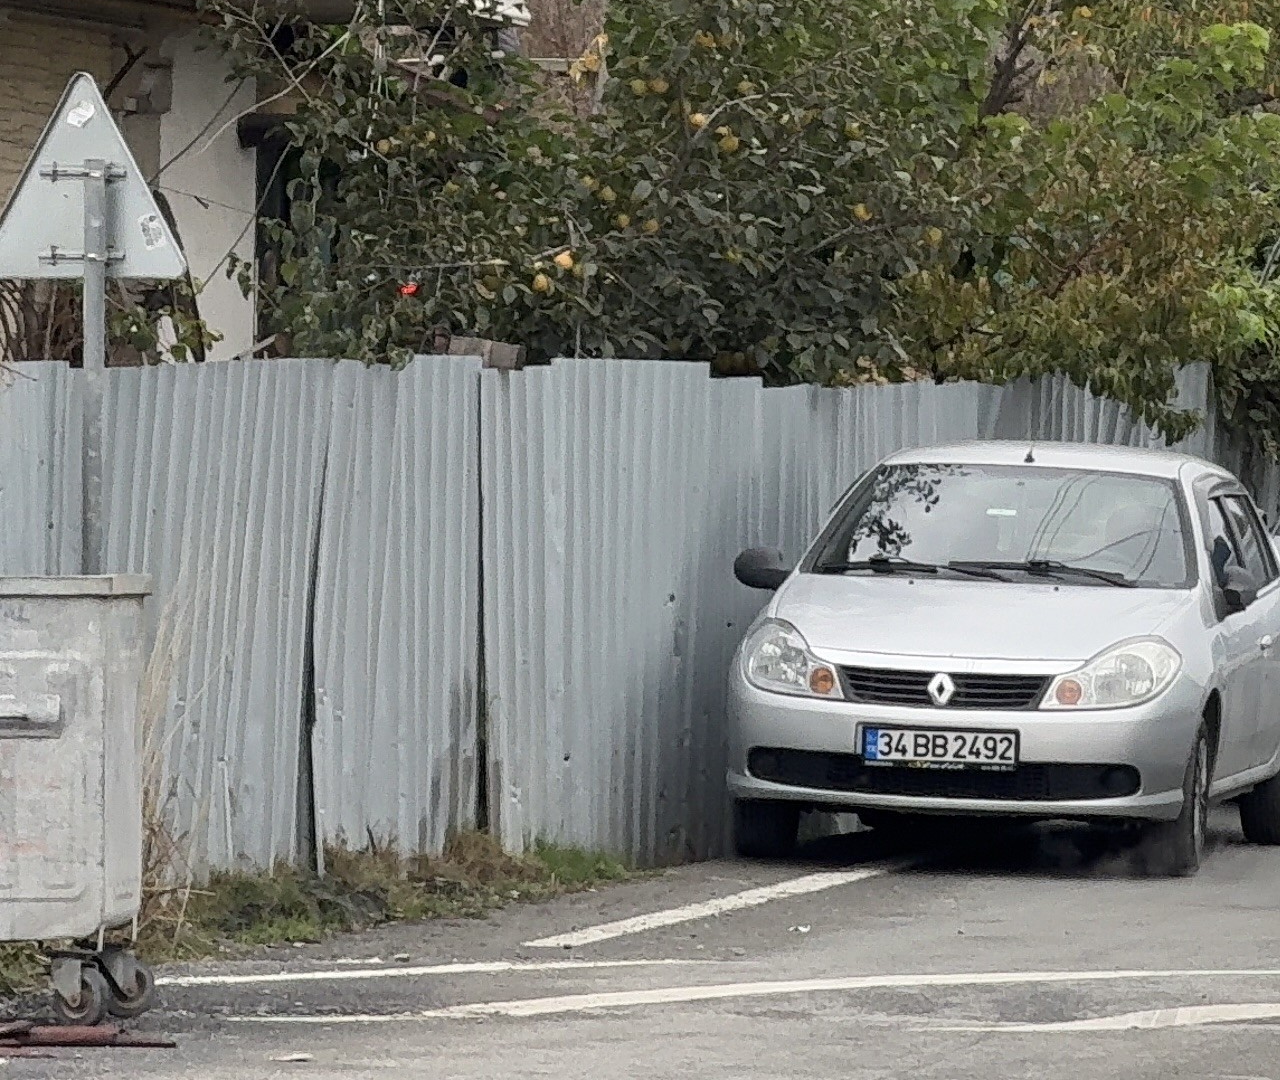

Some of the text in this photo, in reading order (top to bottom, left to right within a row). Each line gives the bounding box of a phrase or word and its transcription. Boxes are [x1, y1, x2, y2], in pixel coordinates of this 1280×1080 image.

[879, 732, 1013, 761] 34 BB 2492
